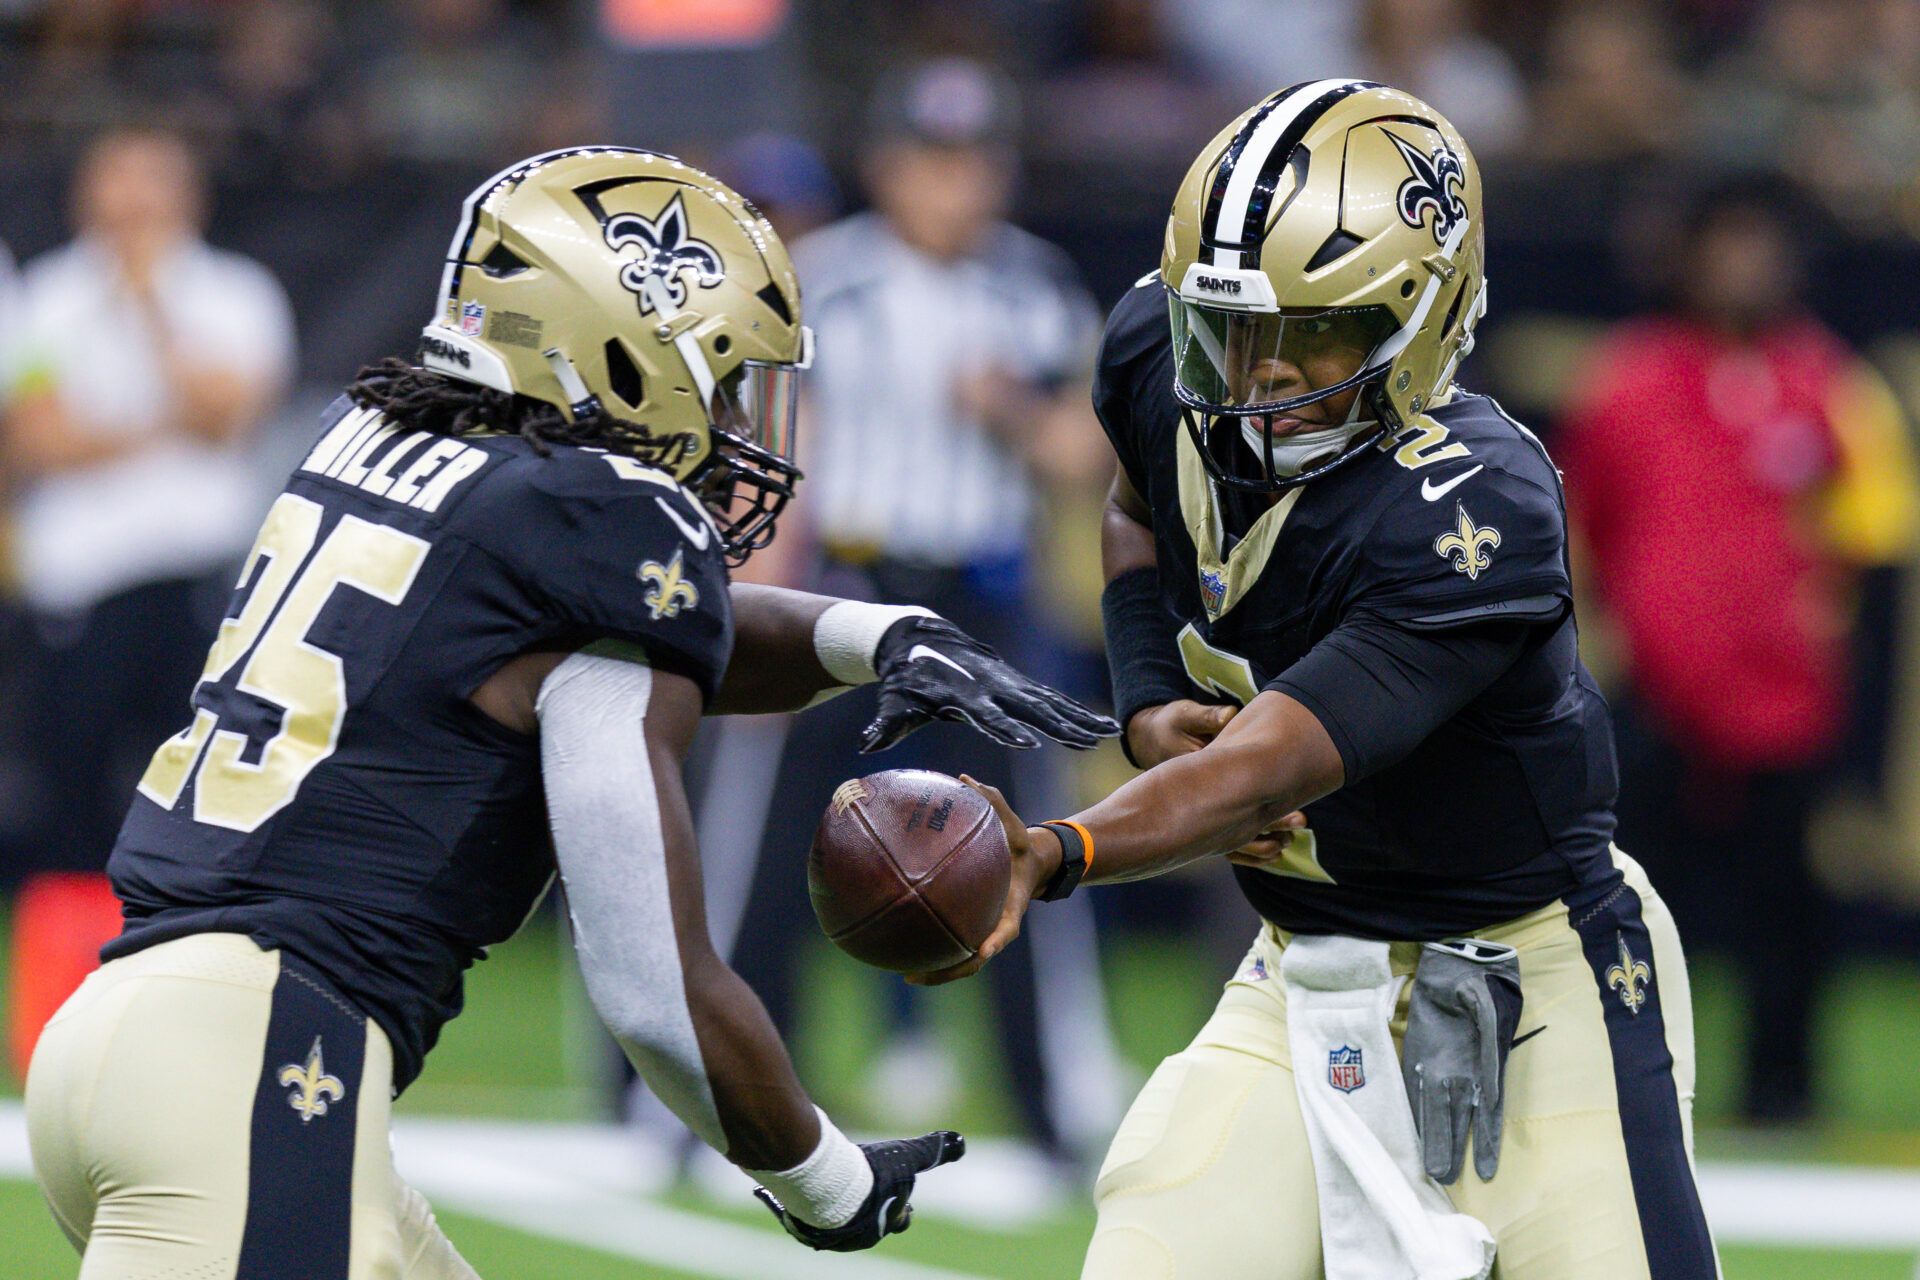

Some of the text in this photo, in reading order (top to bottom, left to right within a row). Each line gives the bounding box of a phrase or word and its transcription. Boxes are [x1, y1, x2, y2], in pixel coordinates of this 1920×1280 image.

[1196, 276, 1241, 293] SAINTS
[301, 406, 490, 513] MILLER
[1377, 413, 1472, 470] 2
[136, 492, 432, 833] 25
[928, 798, 954, 831] Wilson
[1332, 1066, 1361, 1088] NFL
